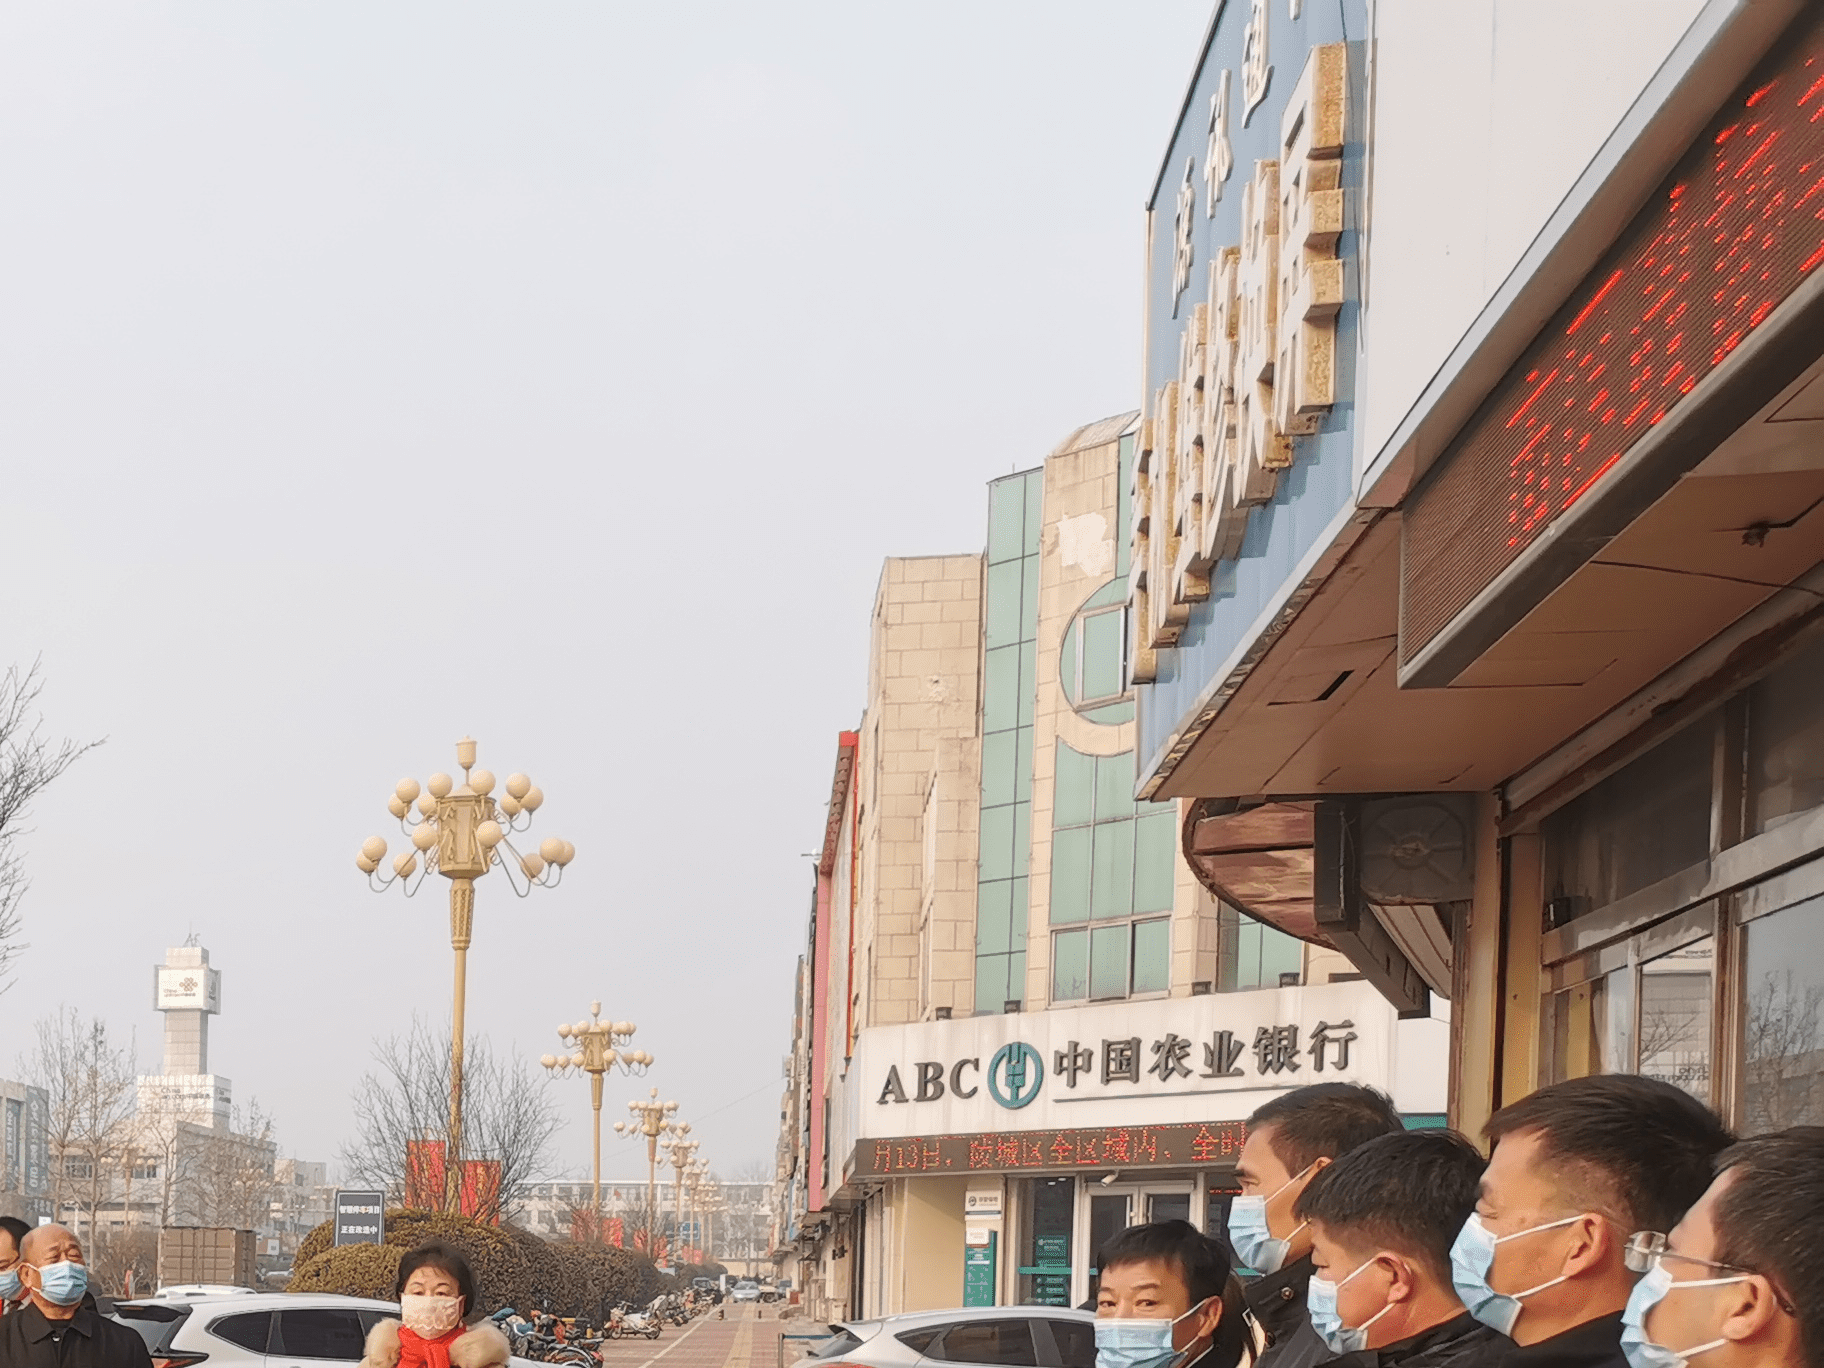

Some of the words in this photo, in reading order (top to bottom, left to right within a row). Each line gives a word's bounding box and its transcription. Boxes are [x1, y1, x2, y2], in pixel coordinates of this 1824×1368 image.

[877, 1058, 979, 1104] ABC
[1052, 1019, 1359, 1089] 中国农业银行
[340, 1225, 378, 1235] 正在改造中
